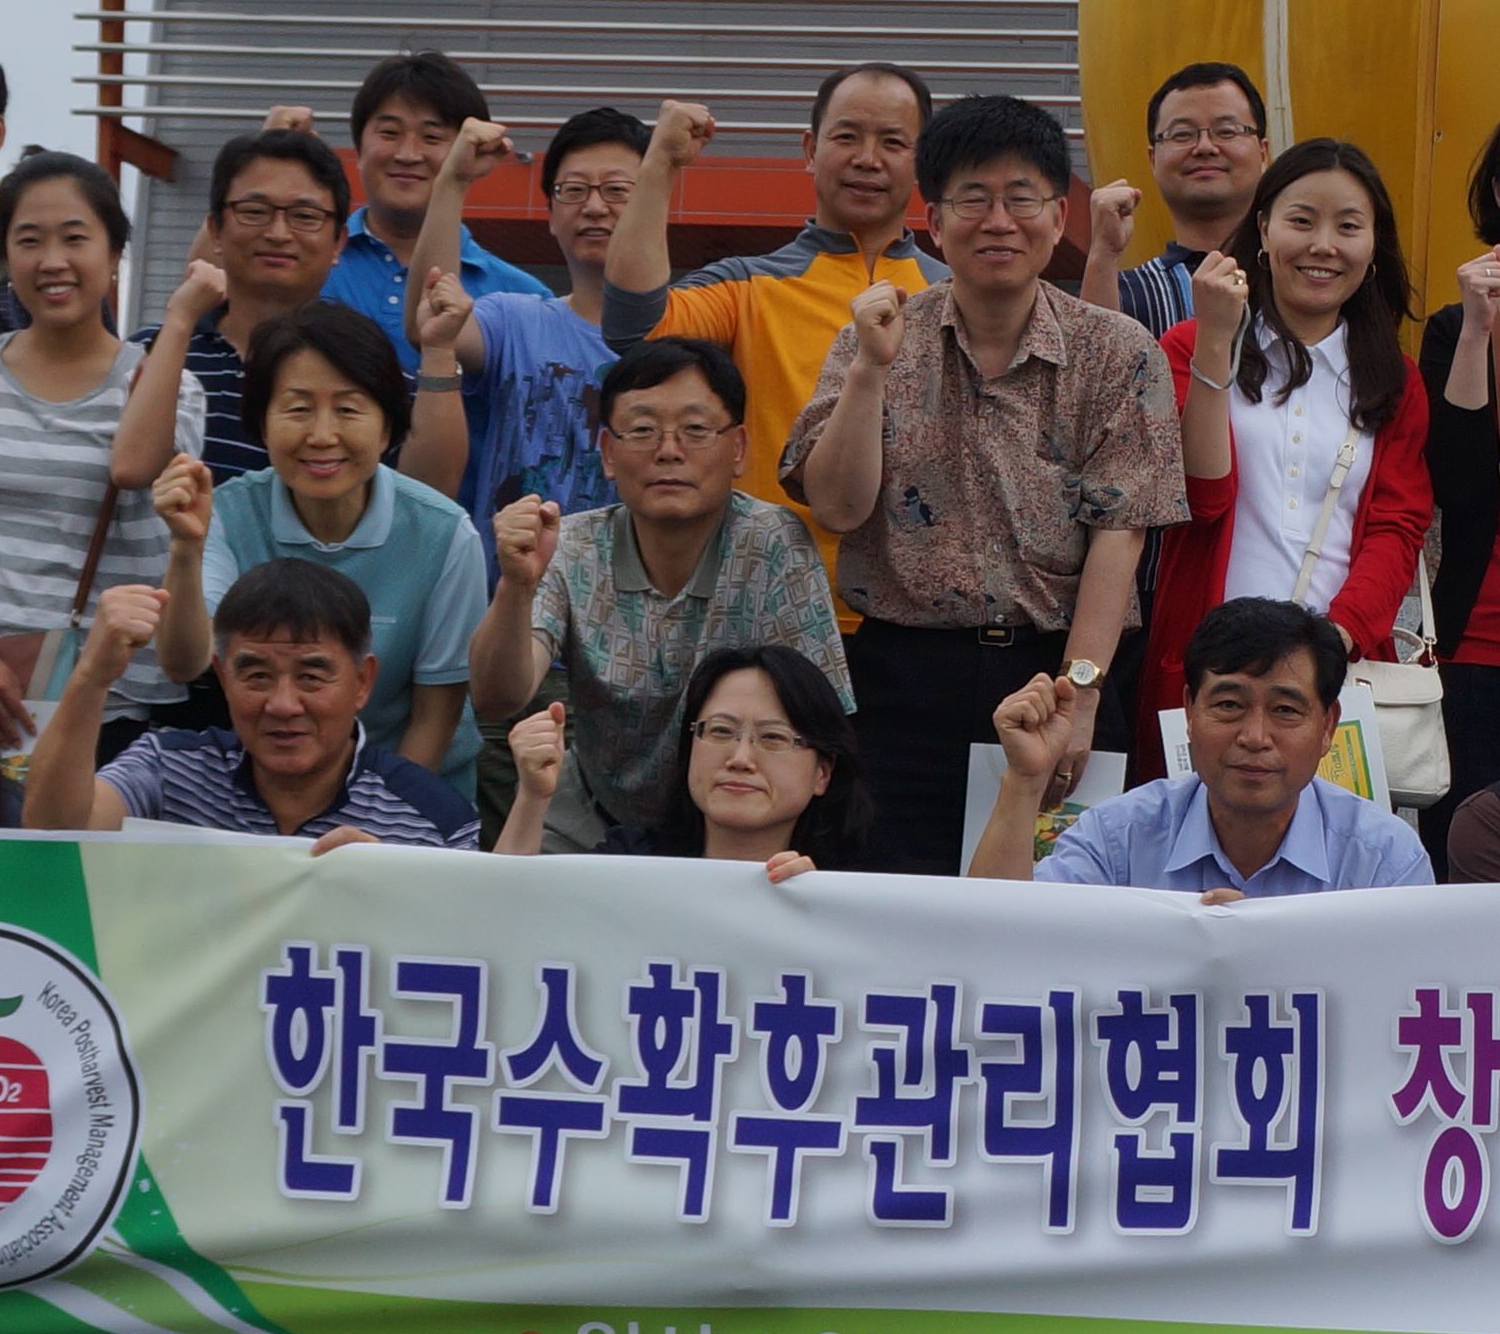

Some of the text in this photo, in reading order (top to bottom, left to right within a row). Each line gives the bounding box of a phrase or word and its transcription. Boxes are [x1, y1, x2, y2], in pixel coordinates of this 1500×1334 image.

[36, 980, 77, 1028] Korea
[69, 1019, 108, 1113] Postharvest
[265, 944, 1320, 1234] 한국수확후관리협회
[55, 1113, 114, 1219] Management
